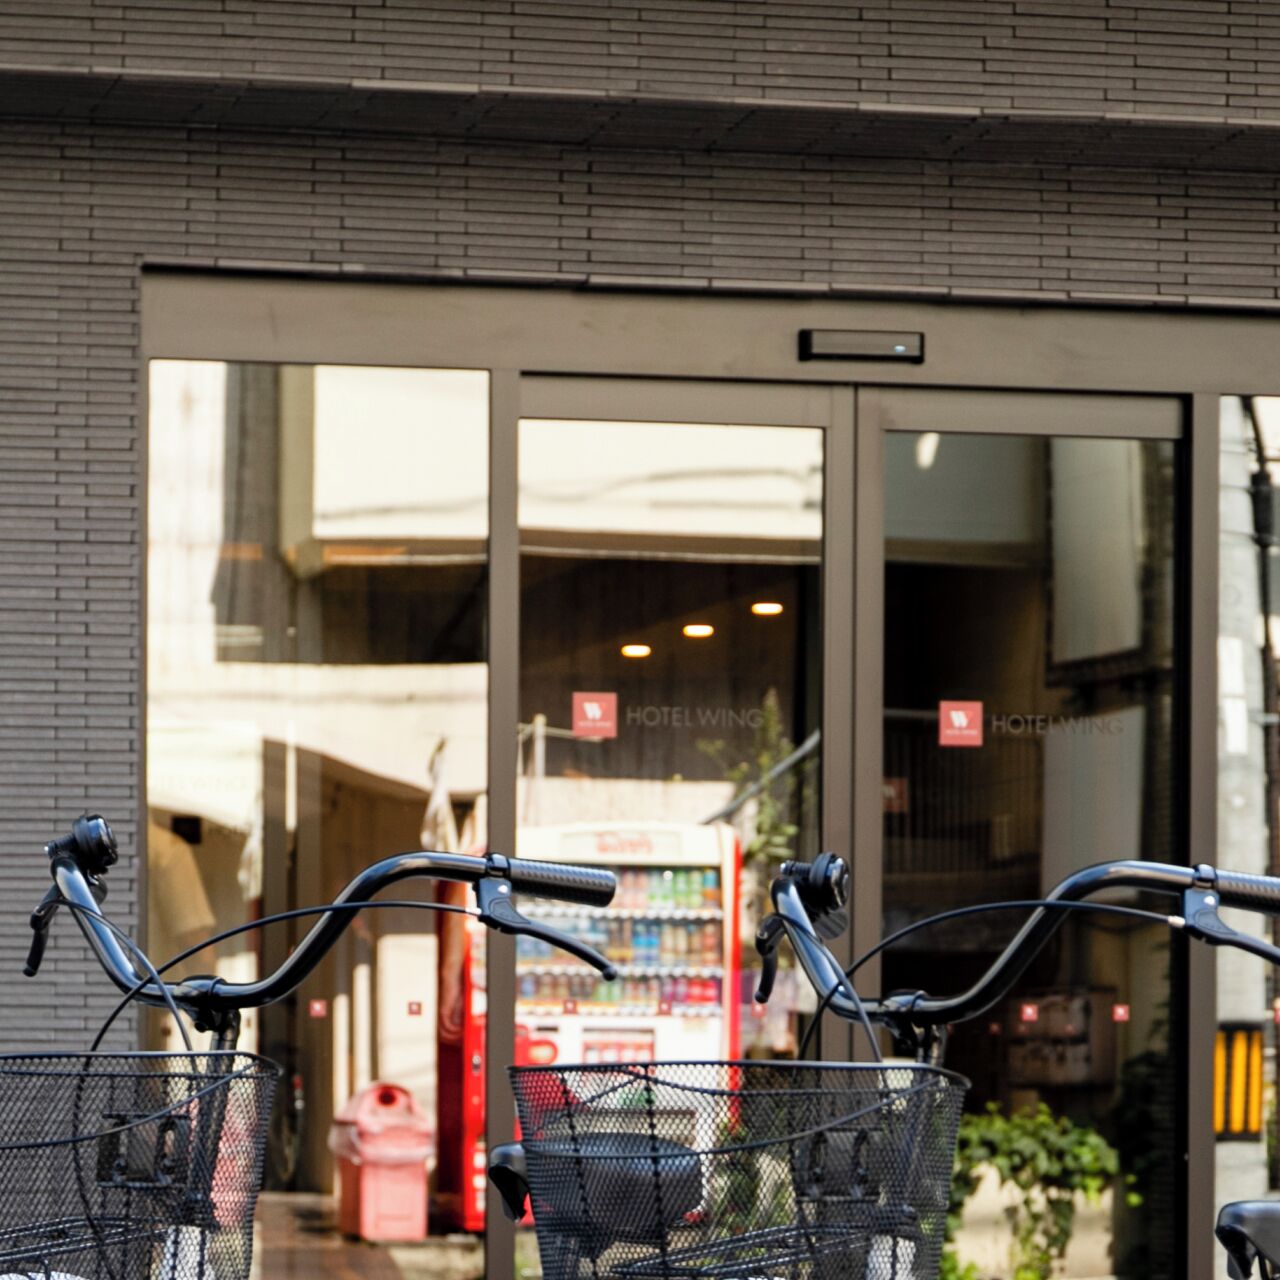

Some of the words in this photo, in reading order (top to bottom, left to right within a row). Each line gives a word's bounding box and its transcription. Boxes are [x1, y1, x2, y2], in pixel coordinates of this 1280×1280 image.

[627, 706, 690, 727] HOTEL
[696, 707, 764, 728] WING
[992, 714, 1055, 734] HOTEL
[1059, 715, 1124, 736] WING
